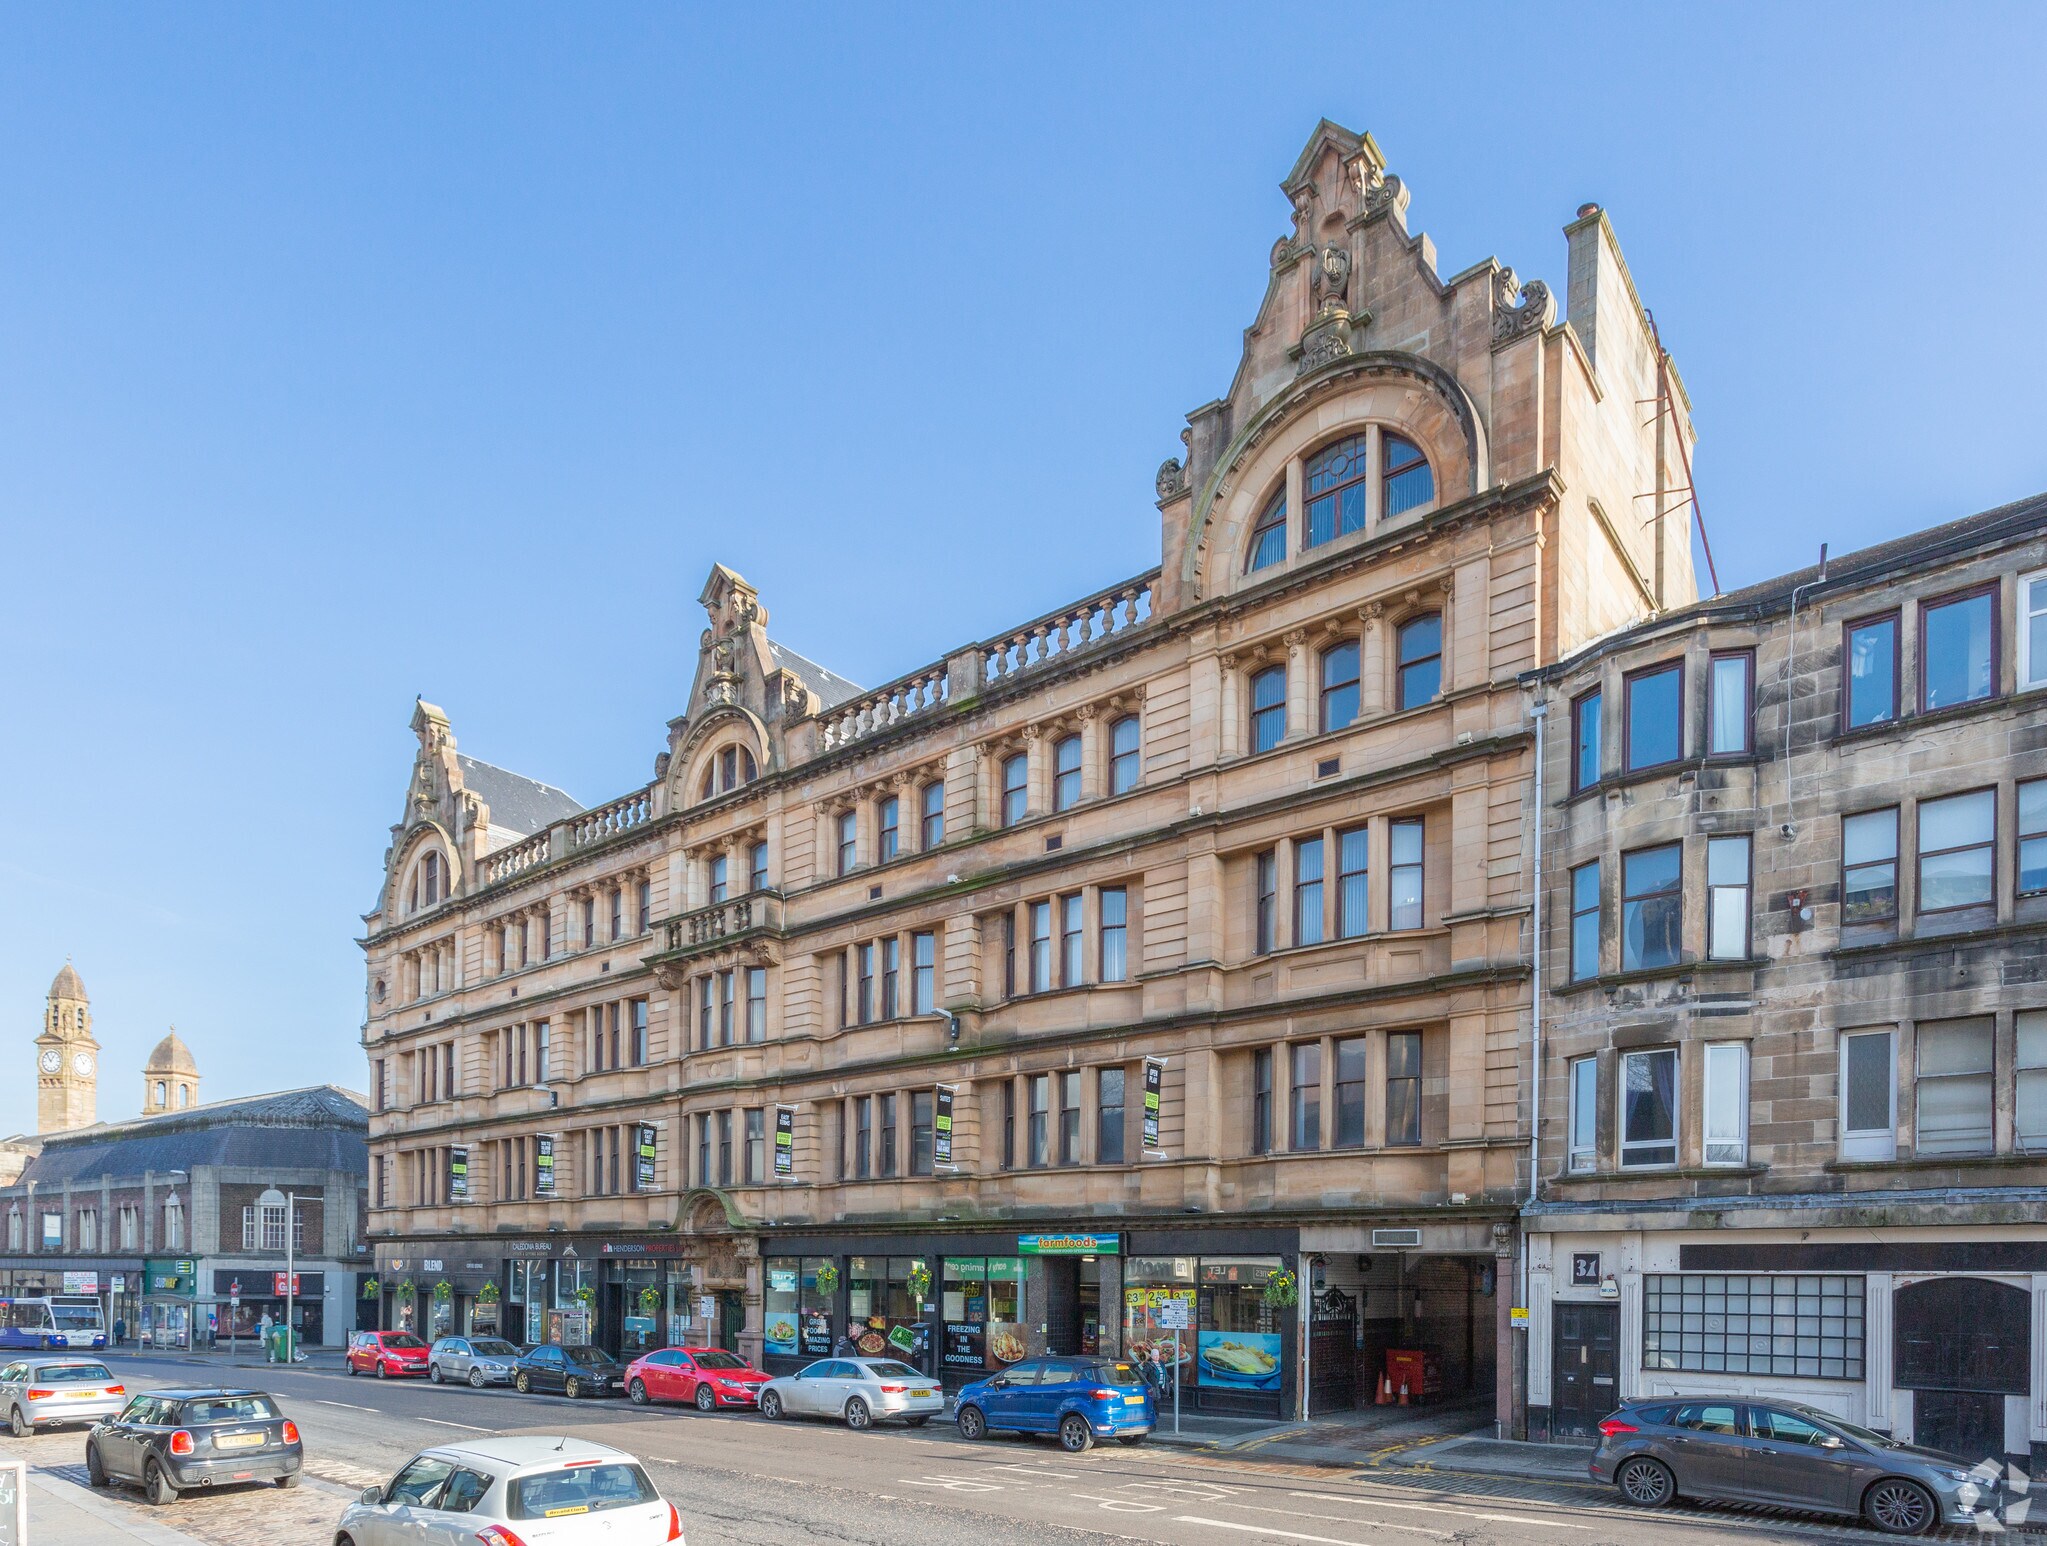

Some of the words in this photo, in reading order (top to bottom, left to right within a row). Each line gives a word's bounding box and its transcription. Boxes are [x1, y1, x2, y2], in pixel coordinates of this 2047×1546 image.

[535, 1242, 552, 1250] BUREAU
[1038, 1237, 1097, 1249] farmfoods
[614, 1244, 645, 1252] HENDERSON
[646, 1244, 675, 1252] PROPERTIES
[424, 1260, 443, 1271] BLEND
[1576, 1260, 1597, 1277] 31
[1149, 1292, 1155, 1301] 2
[948, 1325, 981, 1334] FREEZING
[945, 1354, 983, 1364] GOODNESS
